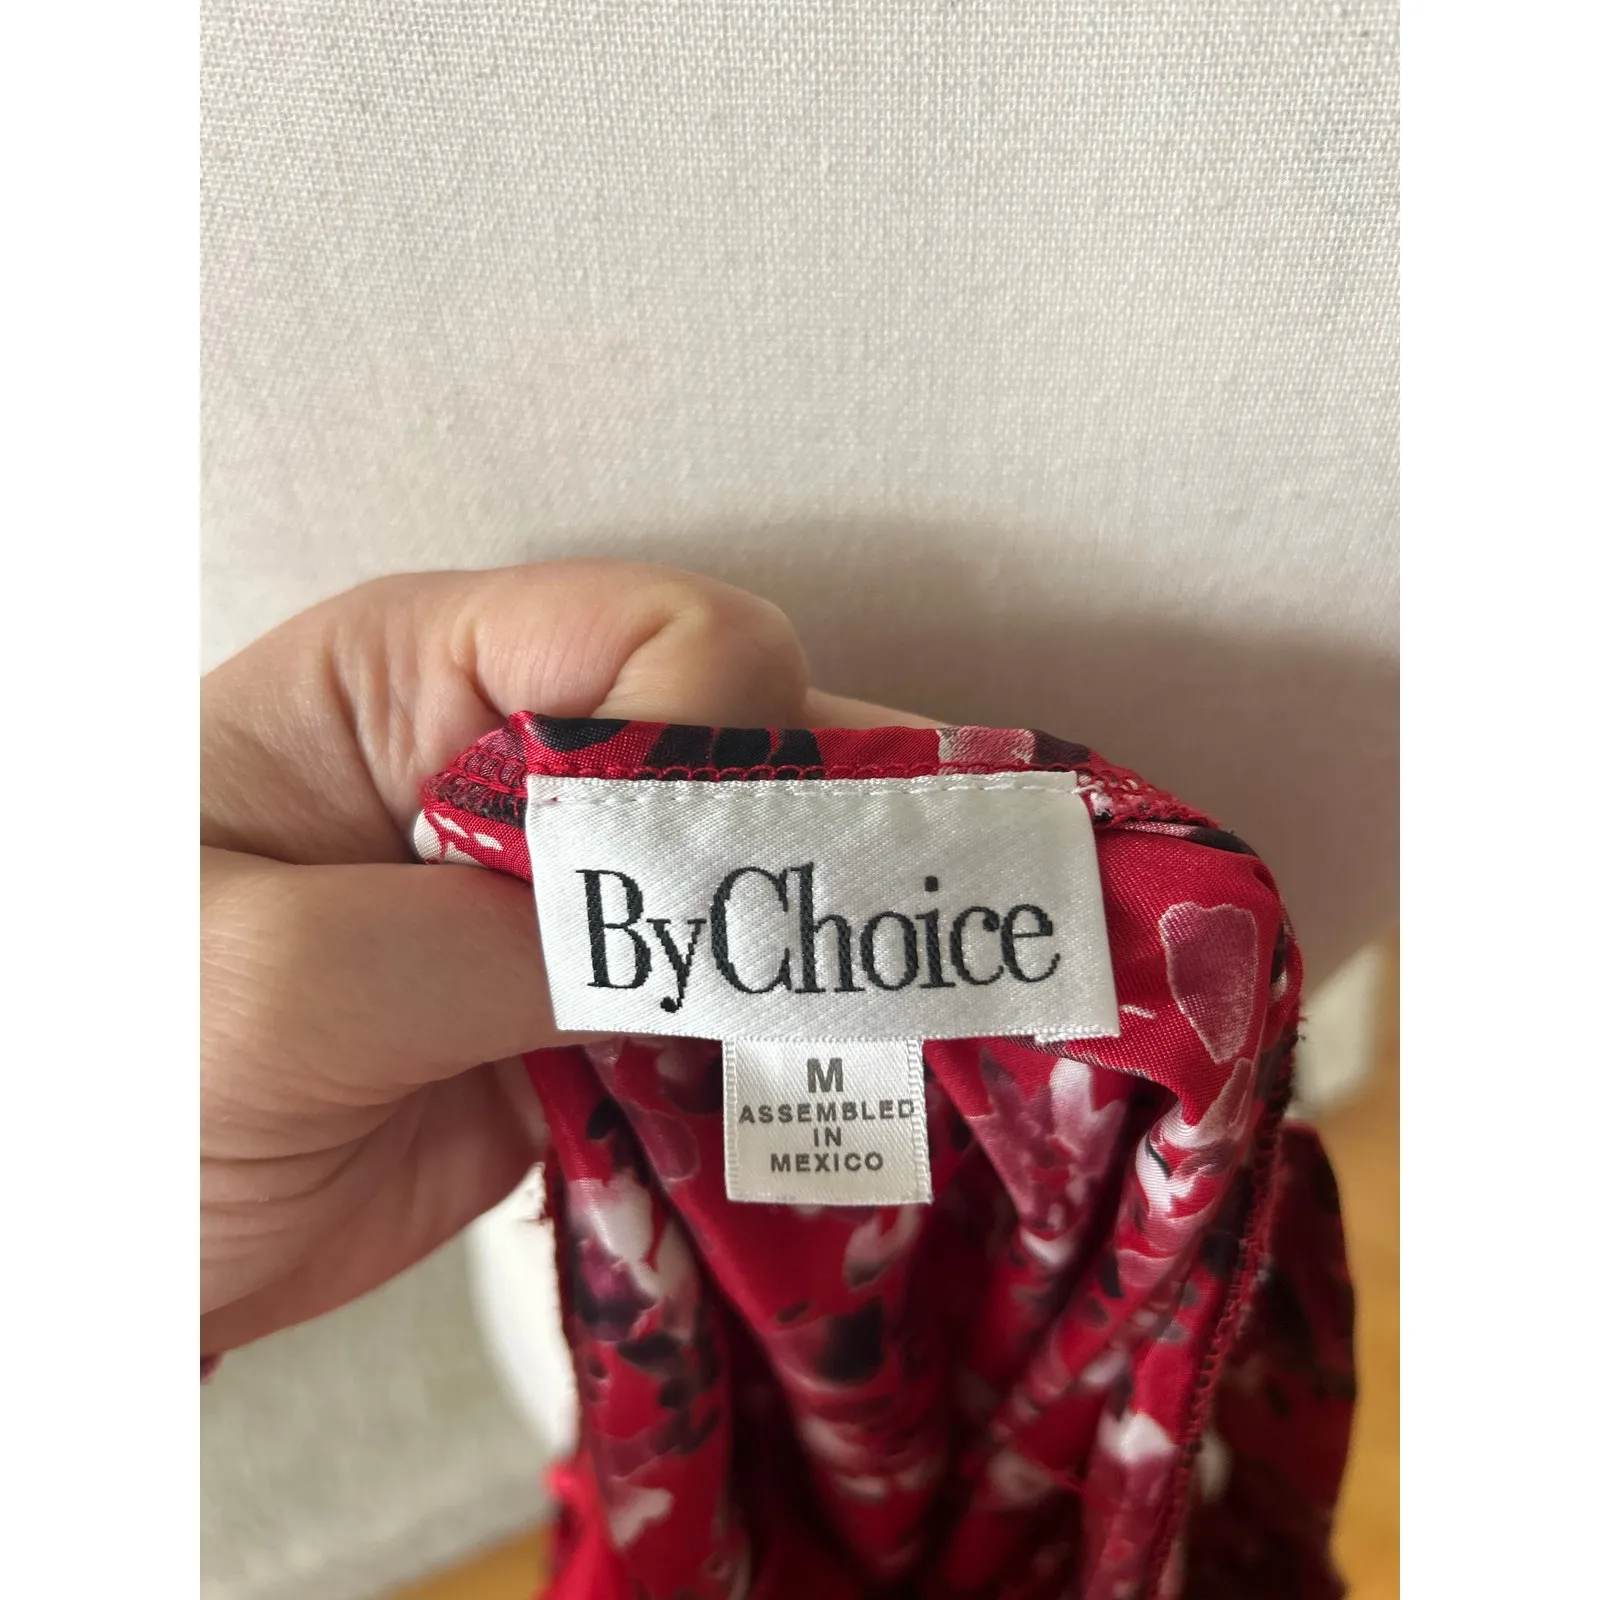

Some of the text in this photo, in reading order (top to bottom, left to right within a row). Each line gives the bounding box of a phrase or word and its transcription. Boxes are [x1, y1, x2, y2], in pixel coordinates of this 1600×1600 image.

[806, 1057, 844, 1094] M
[738, 1099, 915, 1125] ASSEMBLED
[812, 1126, 843, 1148] IN
[770, 1151, 884, 1174] MEXICO
